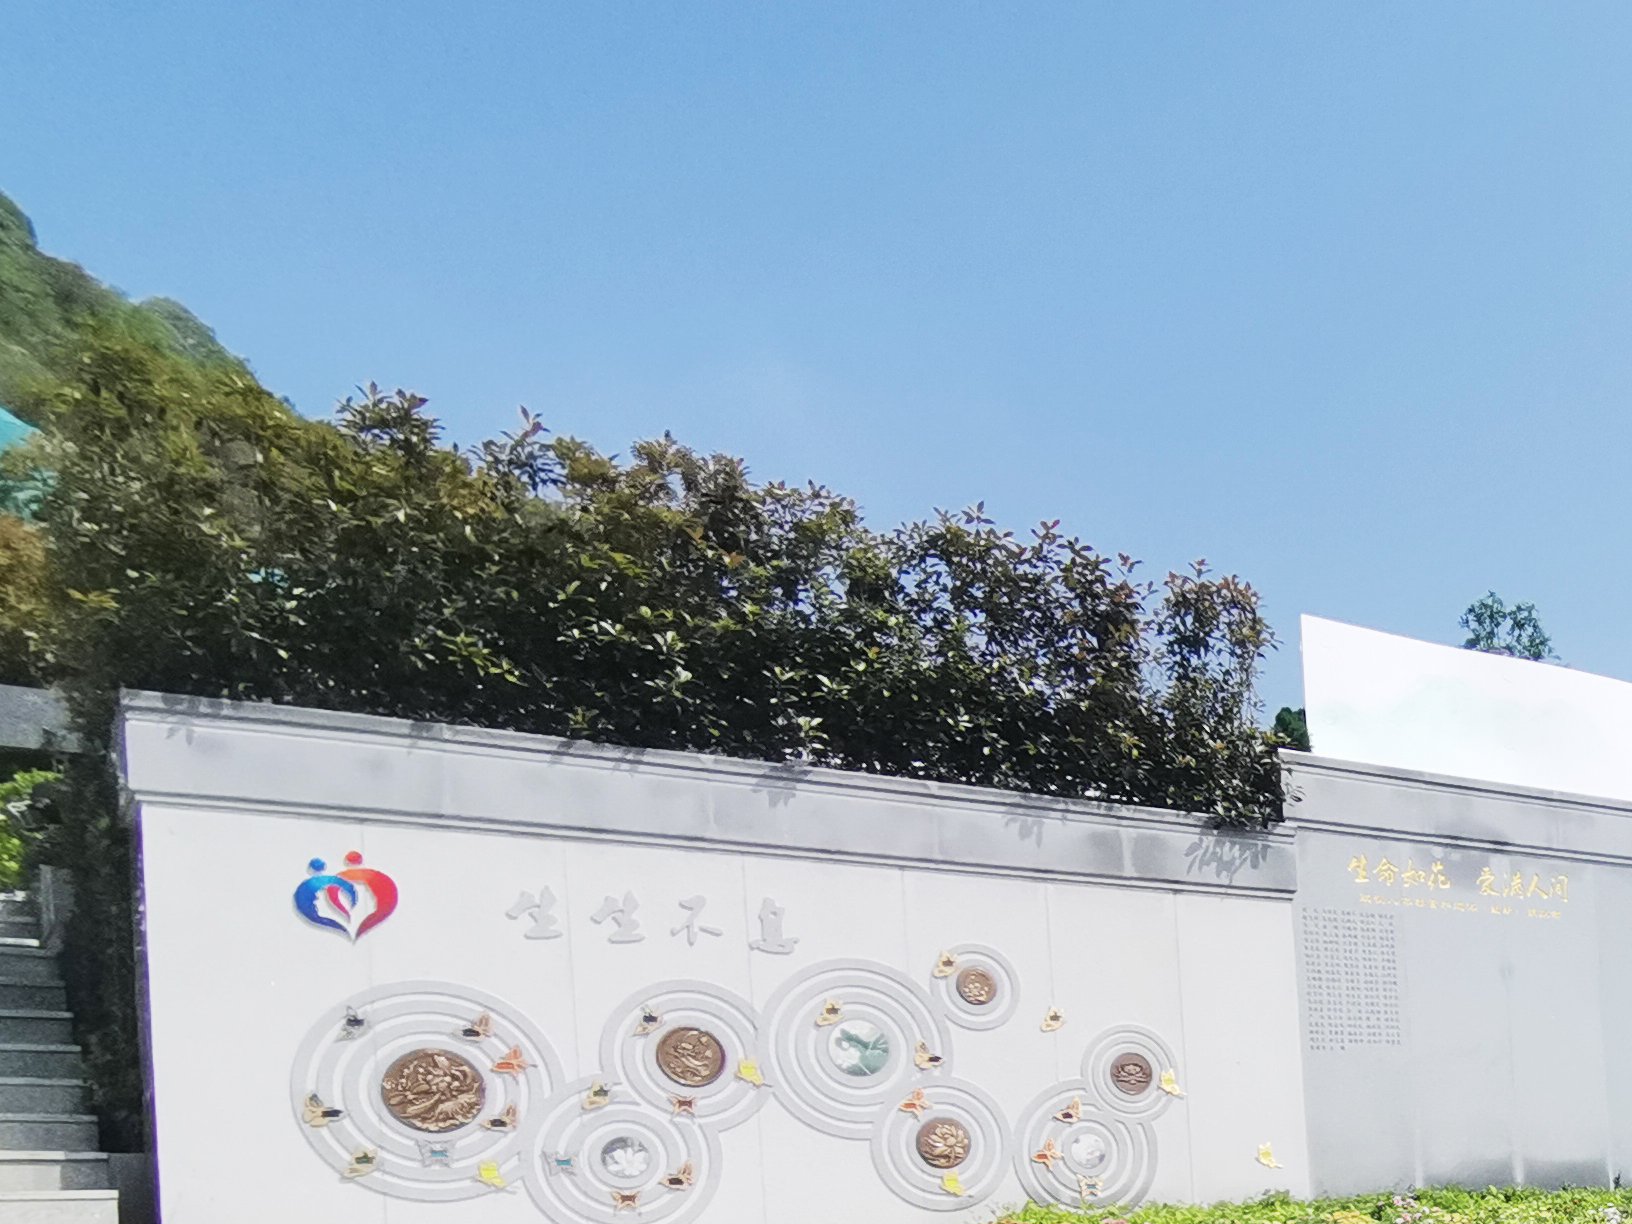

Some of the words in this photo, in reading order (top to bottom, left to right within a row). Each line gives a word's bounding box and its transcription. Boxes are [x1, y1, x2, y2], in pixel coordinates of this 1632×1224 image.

[1347, 853, 1451, 891] 生命如花
[505, 883, 801, 955] 生生不息
